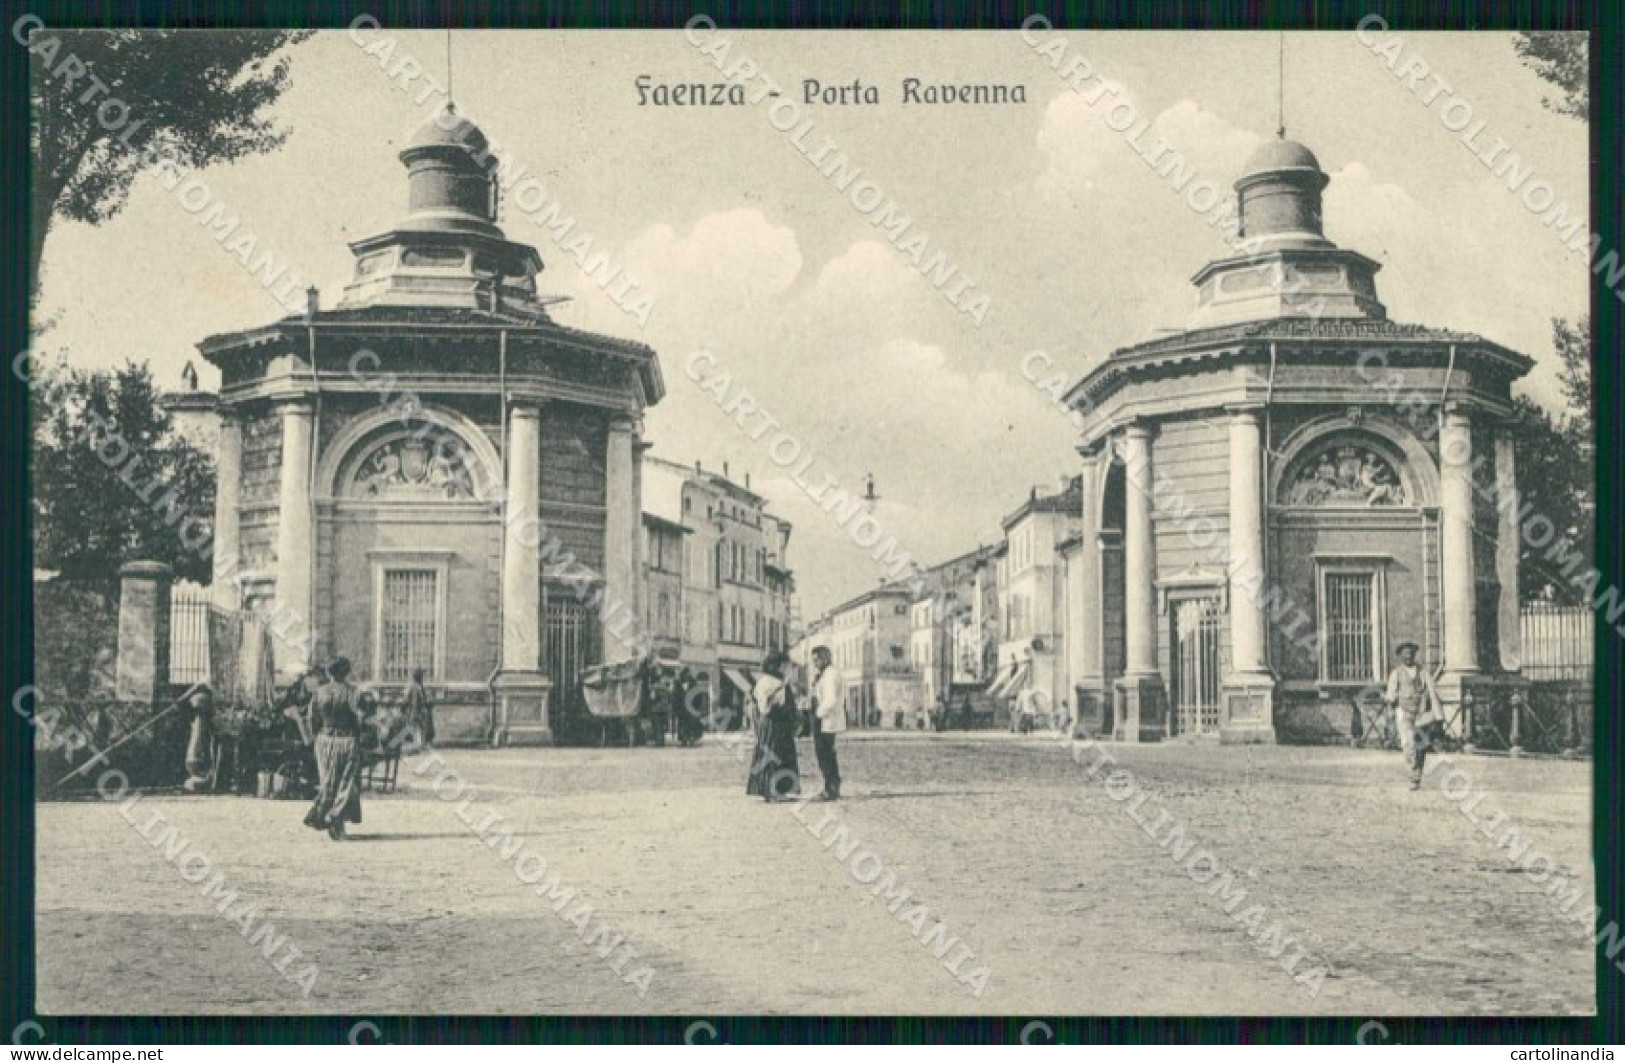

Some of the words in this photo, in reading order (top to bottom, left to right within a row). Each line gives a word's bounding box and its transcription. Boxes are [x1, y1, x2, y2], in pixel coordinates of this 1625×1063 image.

[636, 75, 744, 105] Faenza
[804, 79, 878, 104] Porta
[903, 78, 1026, 103] Ravenna
